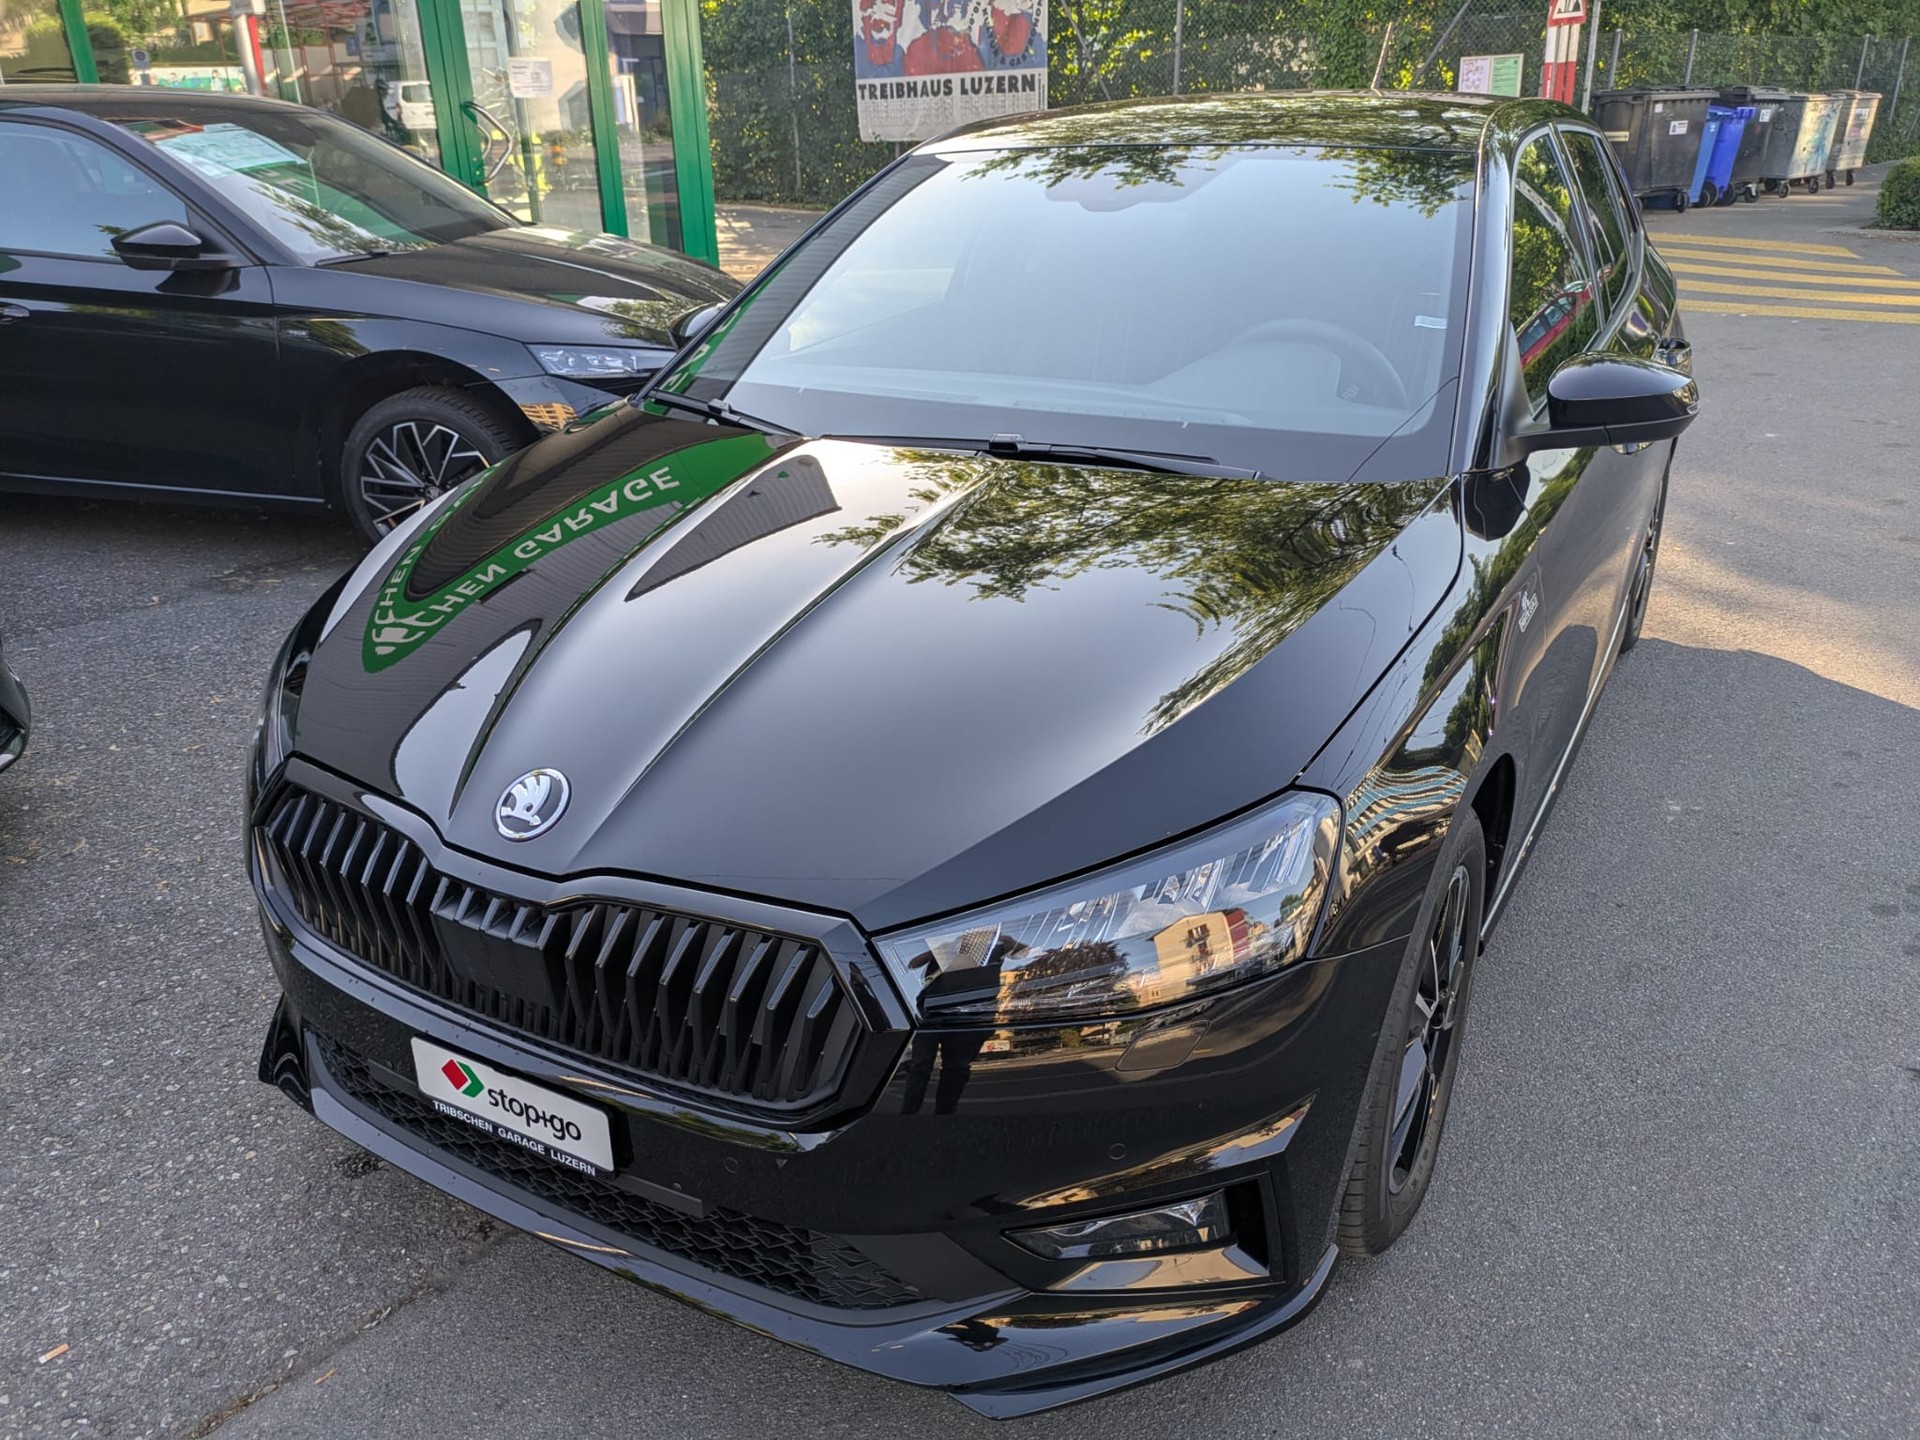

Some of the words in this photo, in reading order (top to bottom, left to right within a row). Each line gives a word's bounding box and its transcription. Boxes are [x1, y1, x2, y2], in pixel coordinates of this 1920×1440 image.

[858, 78, 953, 100] TREIBHAUS
[960, 74, 1036, 96] LUZERN
[432, 1100, 493, 1133] TRIBSCHEN
[498, 1128, 545, 1155] GARAGE
[550, 1150, 596, 1177] LUZERN
[487, 1087, 582, 1142] stop+go
